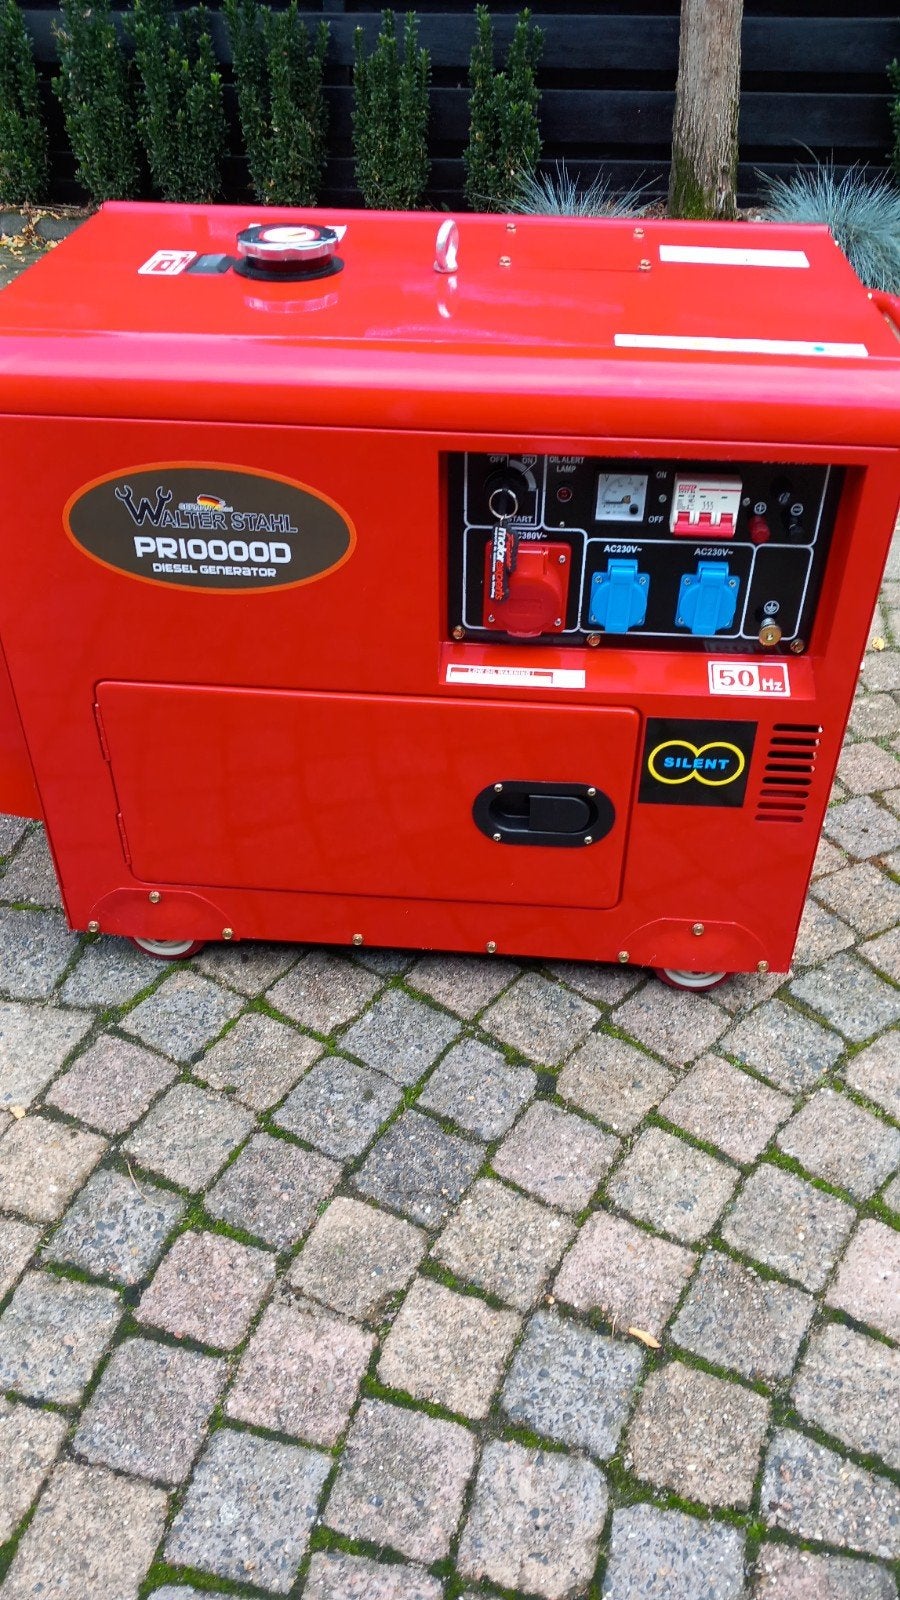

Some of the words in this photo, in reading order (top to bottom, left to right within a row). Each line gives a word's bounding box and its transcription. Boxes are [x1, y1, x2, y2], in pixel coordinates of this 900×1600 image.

[490, 456, 504, 464] OFF
[549, 456, 561, 464] OIL
[561, 456, 585, 464] ALERT
[556, 465, 577, 473] LAMP
[655, 471, 667, 479] ON
[114, 485, 227, 531] WALTER
[231, 512, 298, 533] STAHL
[648, 515, 665, 524] OFF
[153, 562, 198, 574] DIESEL
[718, 669, 755, 687] 50
[761, 678, 784, 691] Hz
[664, 757, 730, 770] SILENT
